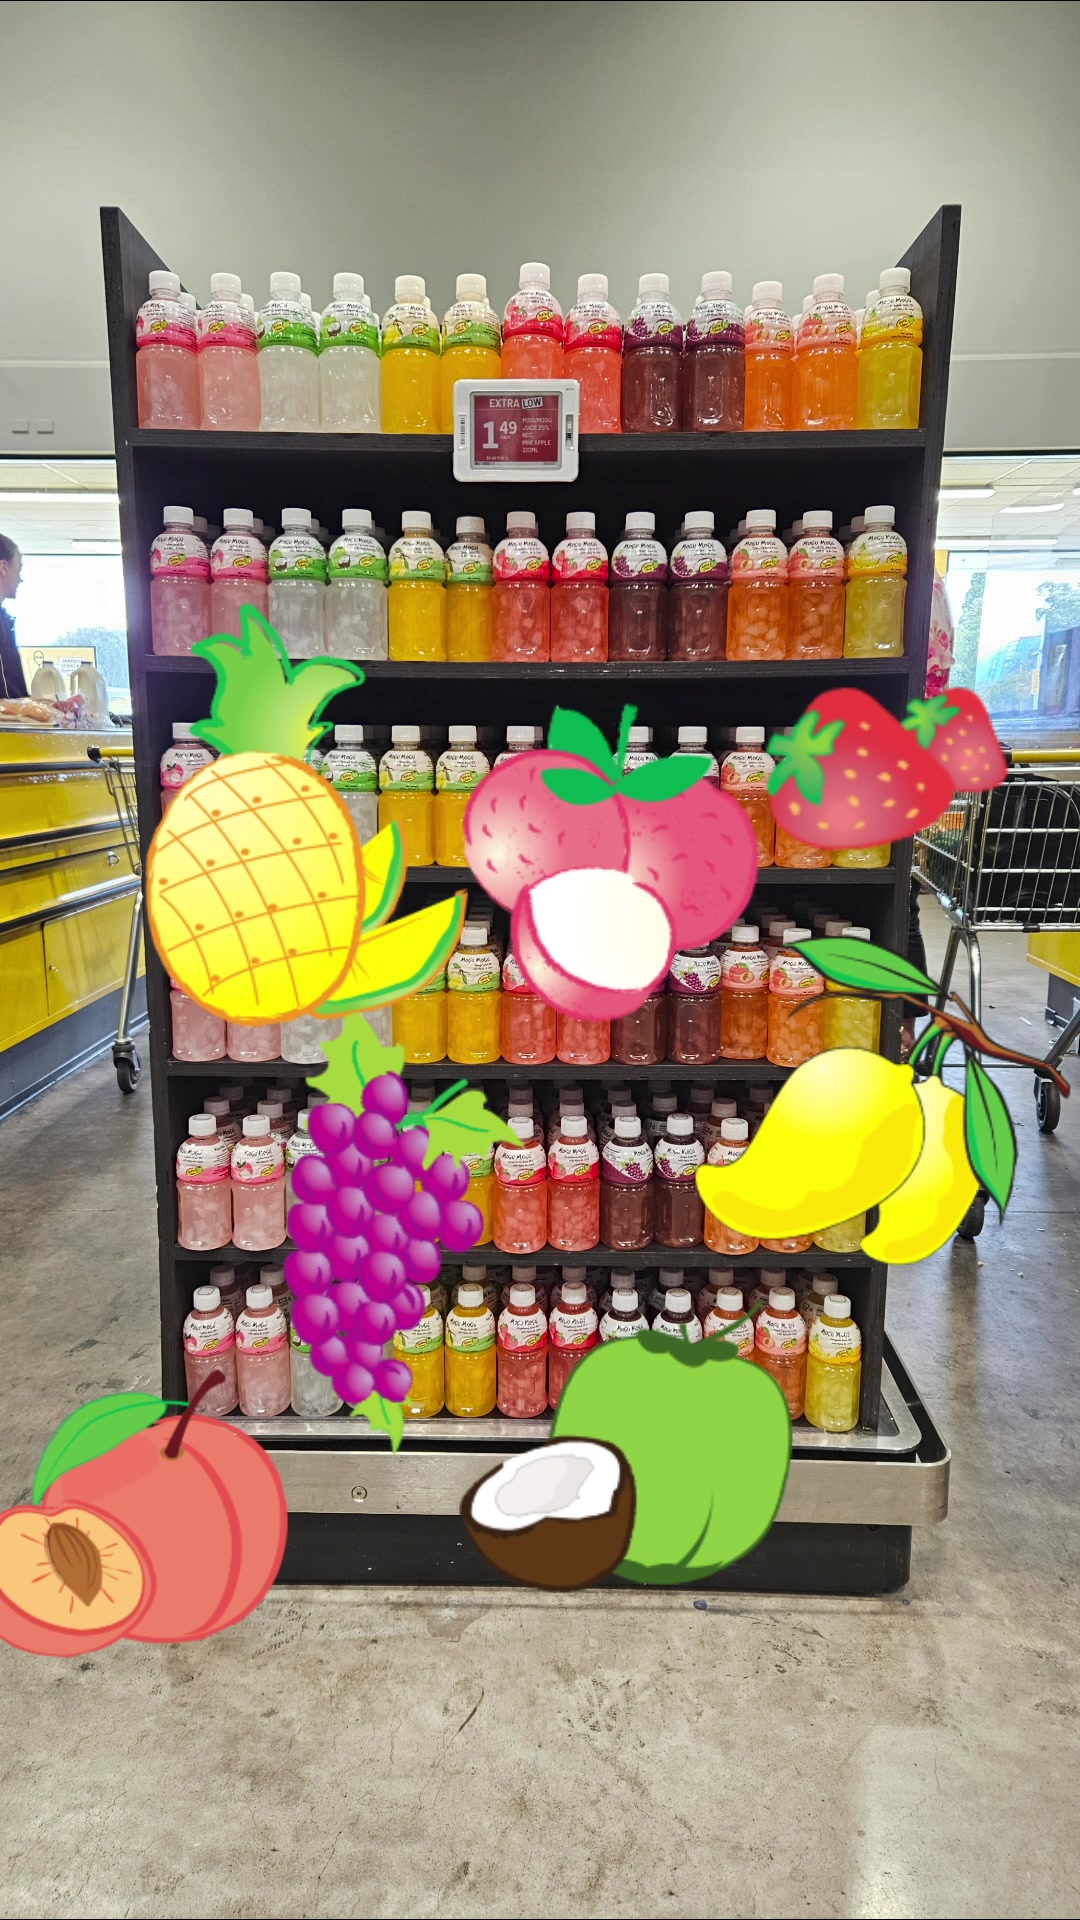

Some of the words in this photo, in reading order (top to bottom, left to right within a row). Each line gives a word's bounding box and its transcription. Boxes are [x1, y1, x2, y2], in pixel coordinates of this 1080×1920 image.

[490, 398, 520, 408] EXTRA
[522, 398, 542, 408] LOW
[500, 420, 518, 434] 49
[482, 421, 498, 448] 1
